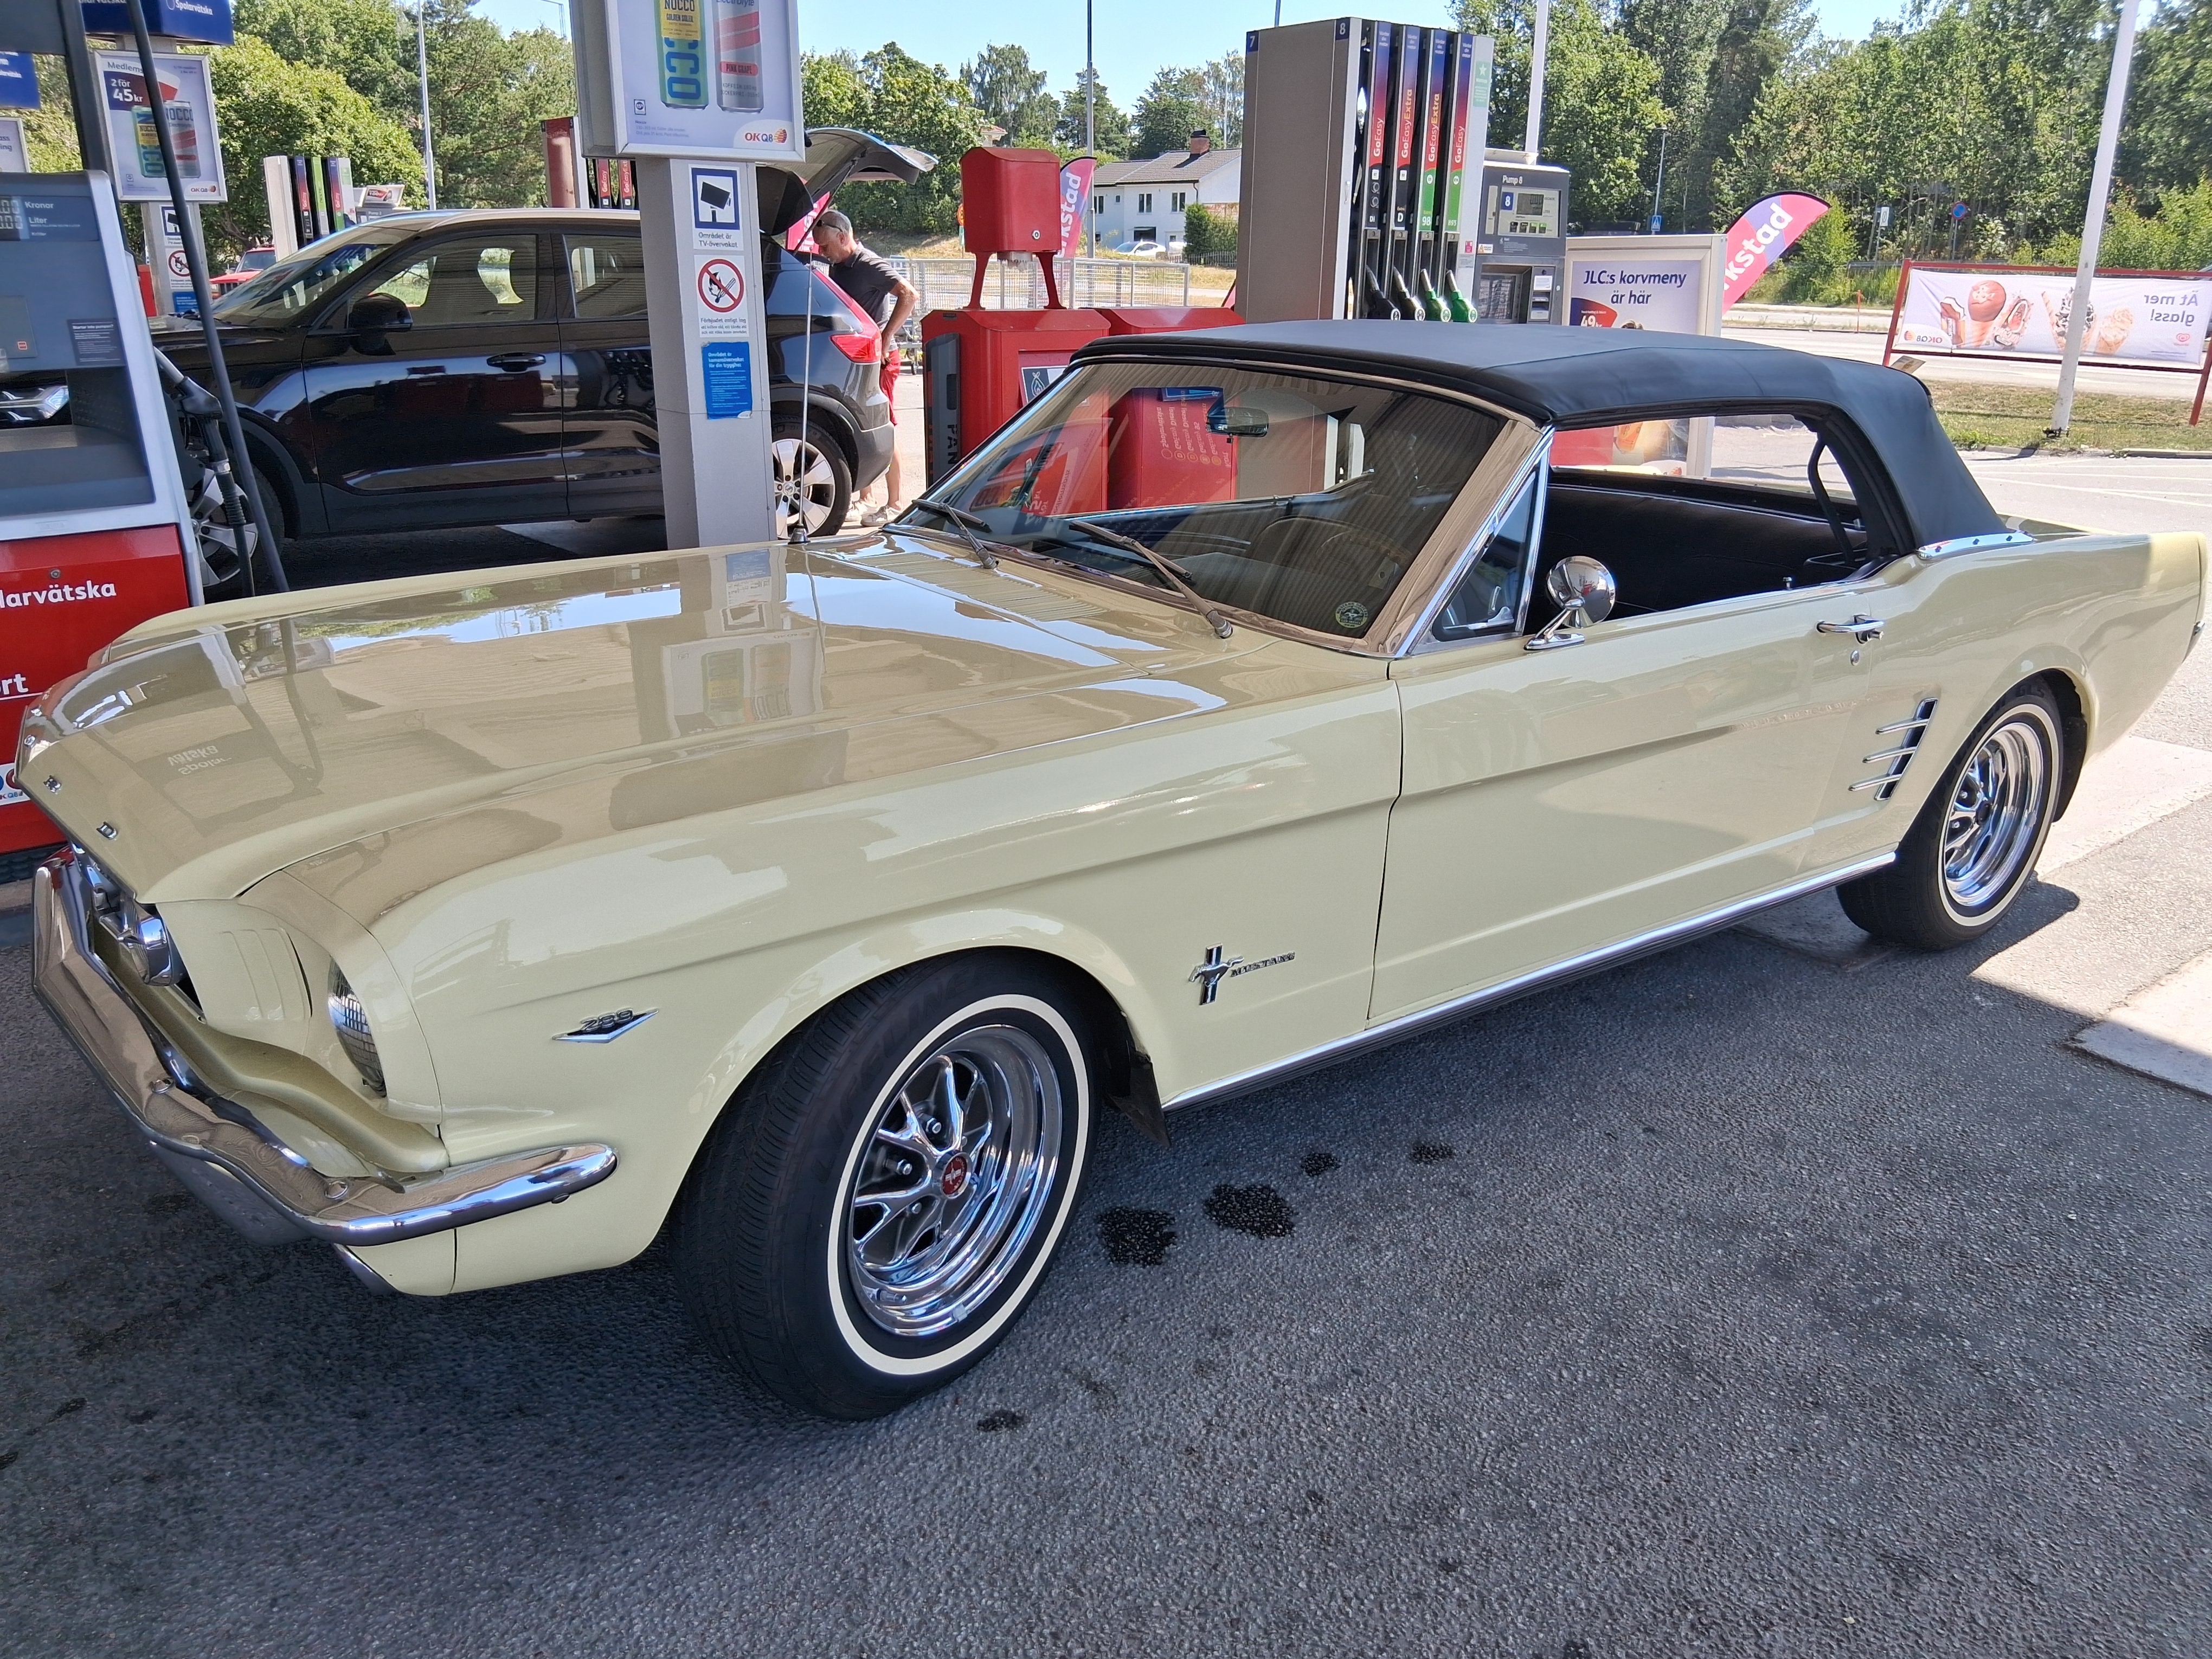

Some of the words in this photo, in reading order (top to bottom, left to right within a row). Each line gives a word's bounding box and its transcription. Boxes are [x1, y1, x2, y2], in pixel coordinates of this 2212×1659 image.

[175, 1, 213, 15] Spolarvätska
[1339, 22, 1346, 35] 8
[1249, 35, 1256, 48] 7
[111, 79, 117, 87] 2
[118, 79, 131, 87] för
[113, 89, 133, 102] 45
[134, 94, 143, 102] kr
[1401, 89, 1412, 158] GoEasyExtra
[1428, 93, 1440, 162] GoEasyExtra
[1373, 118, 1385, 157] GoEasy
[1455, 126, 1465, 163] GoEasy
[1502, 175, 1518, 185] Pump
[1519, 176, 1523, 184] 8
[1504, 195, 1511, 207] 8
[1397, 213, 1404, 222] D
[1422, 216, 1431, 226] 98
[1583, 270, 1616, 285] JLC:s
[1619, 270, 1687, 288] korvmeny
[1611, 290, 1625, 304] är
[1628, 290, 1652, 304] här
[0, 673, 29, 696] rt
[1230, 950, 1296, 978] MUSTANG
[580, 1007, 634, 1032] 289
